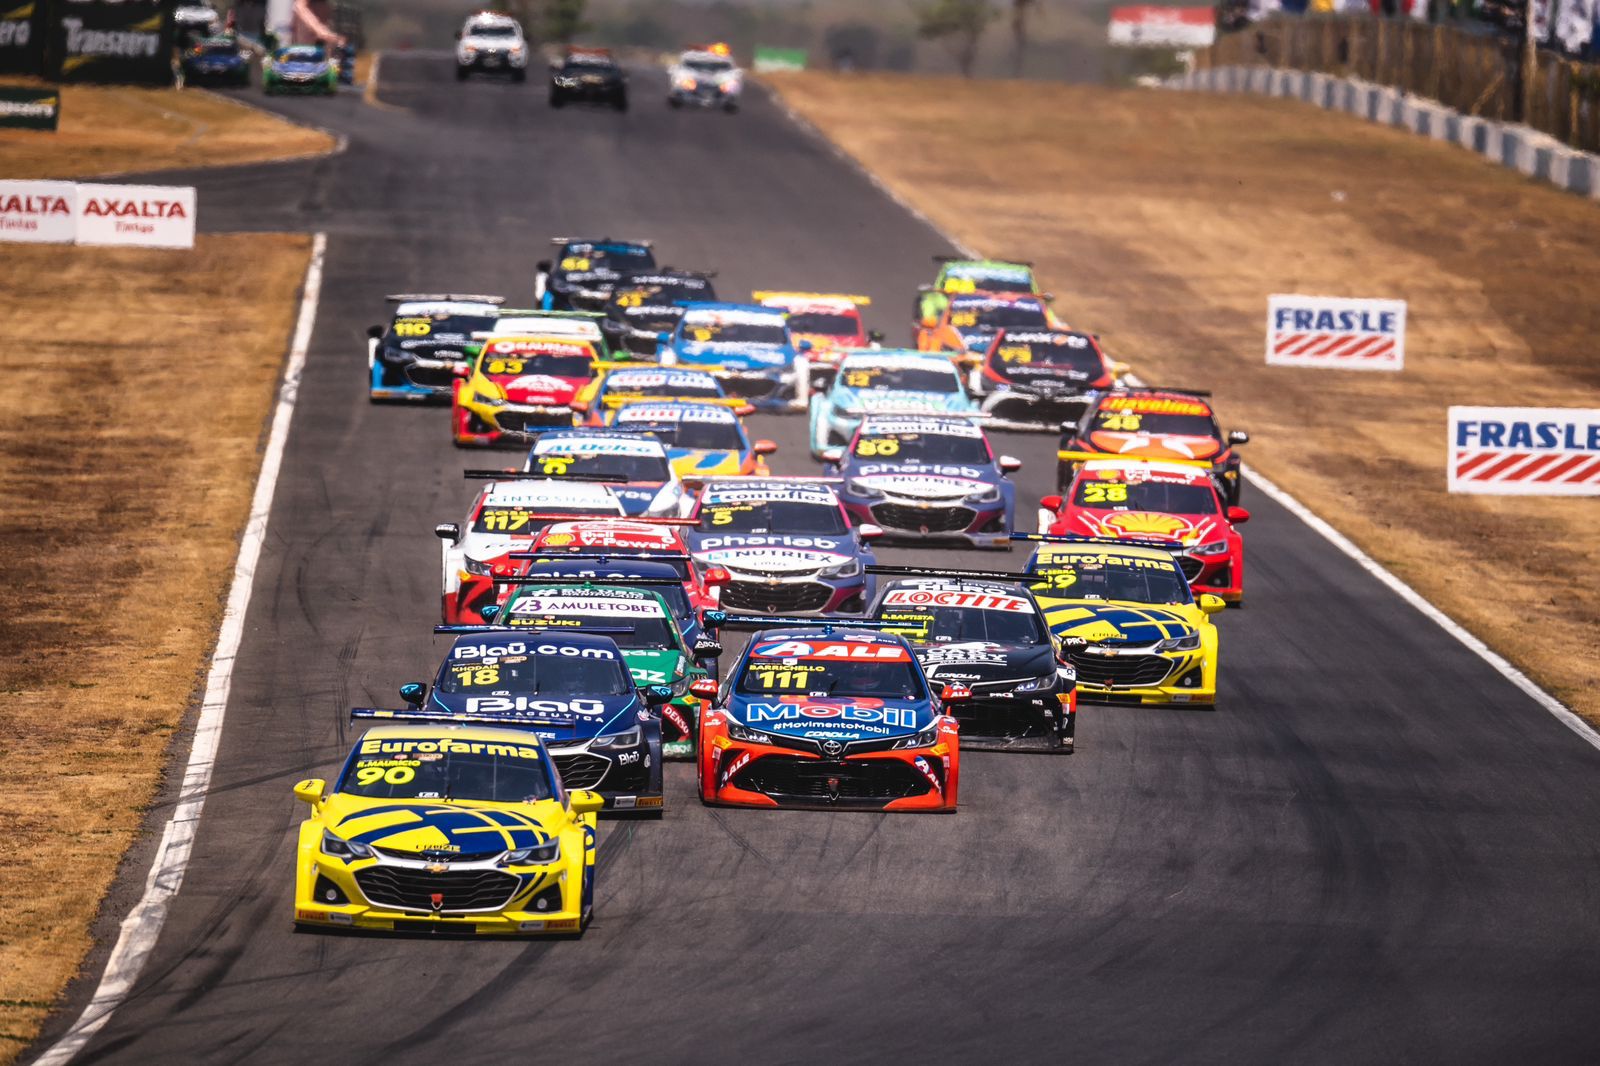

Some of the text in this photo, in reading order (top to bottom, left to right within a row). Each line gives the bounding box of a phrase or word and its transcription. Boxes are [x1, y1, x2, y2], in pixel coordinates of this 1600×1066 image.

[84, 199, 186, 218] AXALTA
[1084, 487, 1127, 503] 28
[484, 515, 529, 531] 117
[712, 511, 733, 525] 5
[735, 550, 832, 563] NUTRIEX
[1037, 553, 1175, 572] Eurofarma
[547, 602, 659, 614] AMULETOBET
[887, 591, 1027, 611] LOCTITE
[509, 619, 581, 627] SUZUKI
[813, 645, 904, 658] ALE
[749, 664, 825, 673] BARRICHELLO
[457, 668, 500, 687] 18
[758, 671, 809, 689] 111
[664, 706, 690, 734] DENSO
[747, 703, 917, 729] Mobil
[773, 721, 890, 735] #MovimentoMobil
[360, 738, 539, 760] Eurofarma
[356, 767, 416, 787] 90
